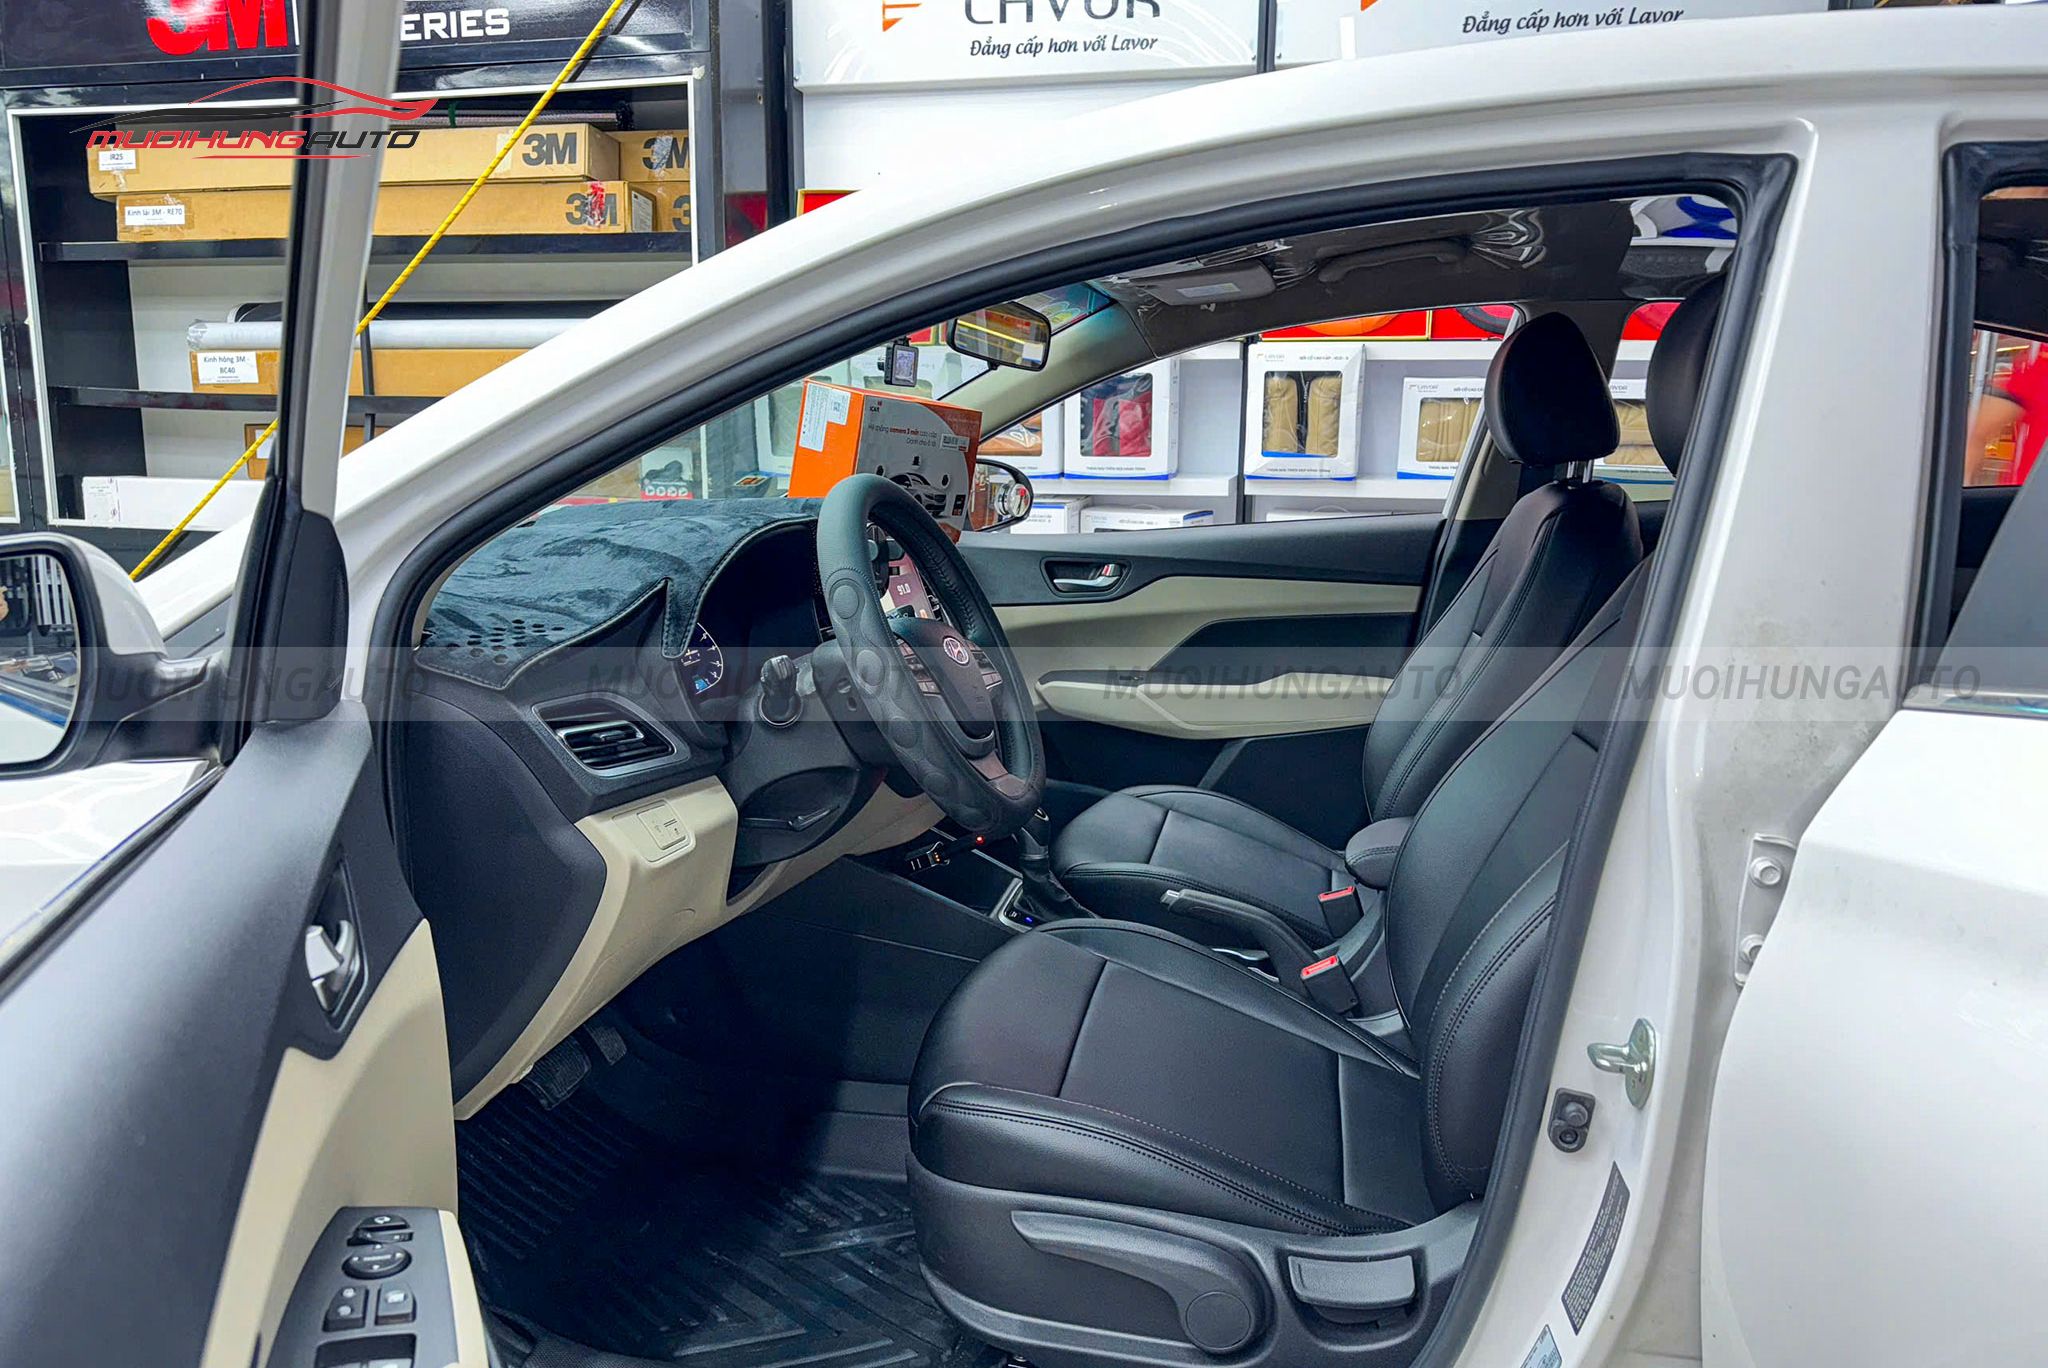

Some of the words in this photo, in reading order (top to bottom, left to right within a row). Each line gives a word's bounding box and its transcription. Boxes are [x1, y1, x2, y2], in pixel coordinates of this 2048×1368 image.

[400, 8, 511, 41] ERIES
[1462, 11, 1511, 35] Đẳng
[1516, 8, 1550, 32] cấp
[1553, 11, 1589, 28] hơn
[1595, 7, 1625, 26] với
[1628, 7, 1684, 25] Lavor
[970, 36, 1011, 59] Đẳng
[1015, 35, 1043, 58] cấp
[1048, 37, 1079, 54] hơn
[1083, 34, 1106, 52] với
[1111, 34, 1159, 51] Lavor
[521, 132, 577, 166] 3M
[671, 194, 690, 232] 3
